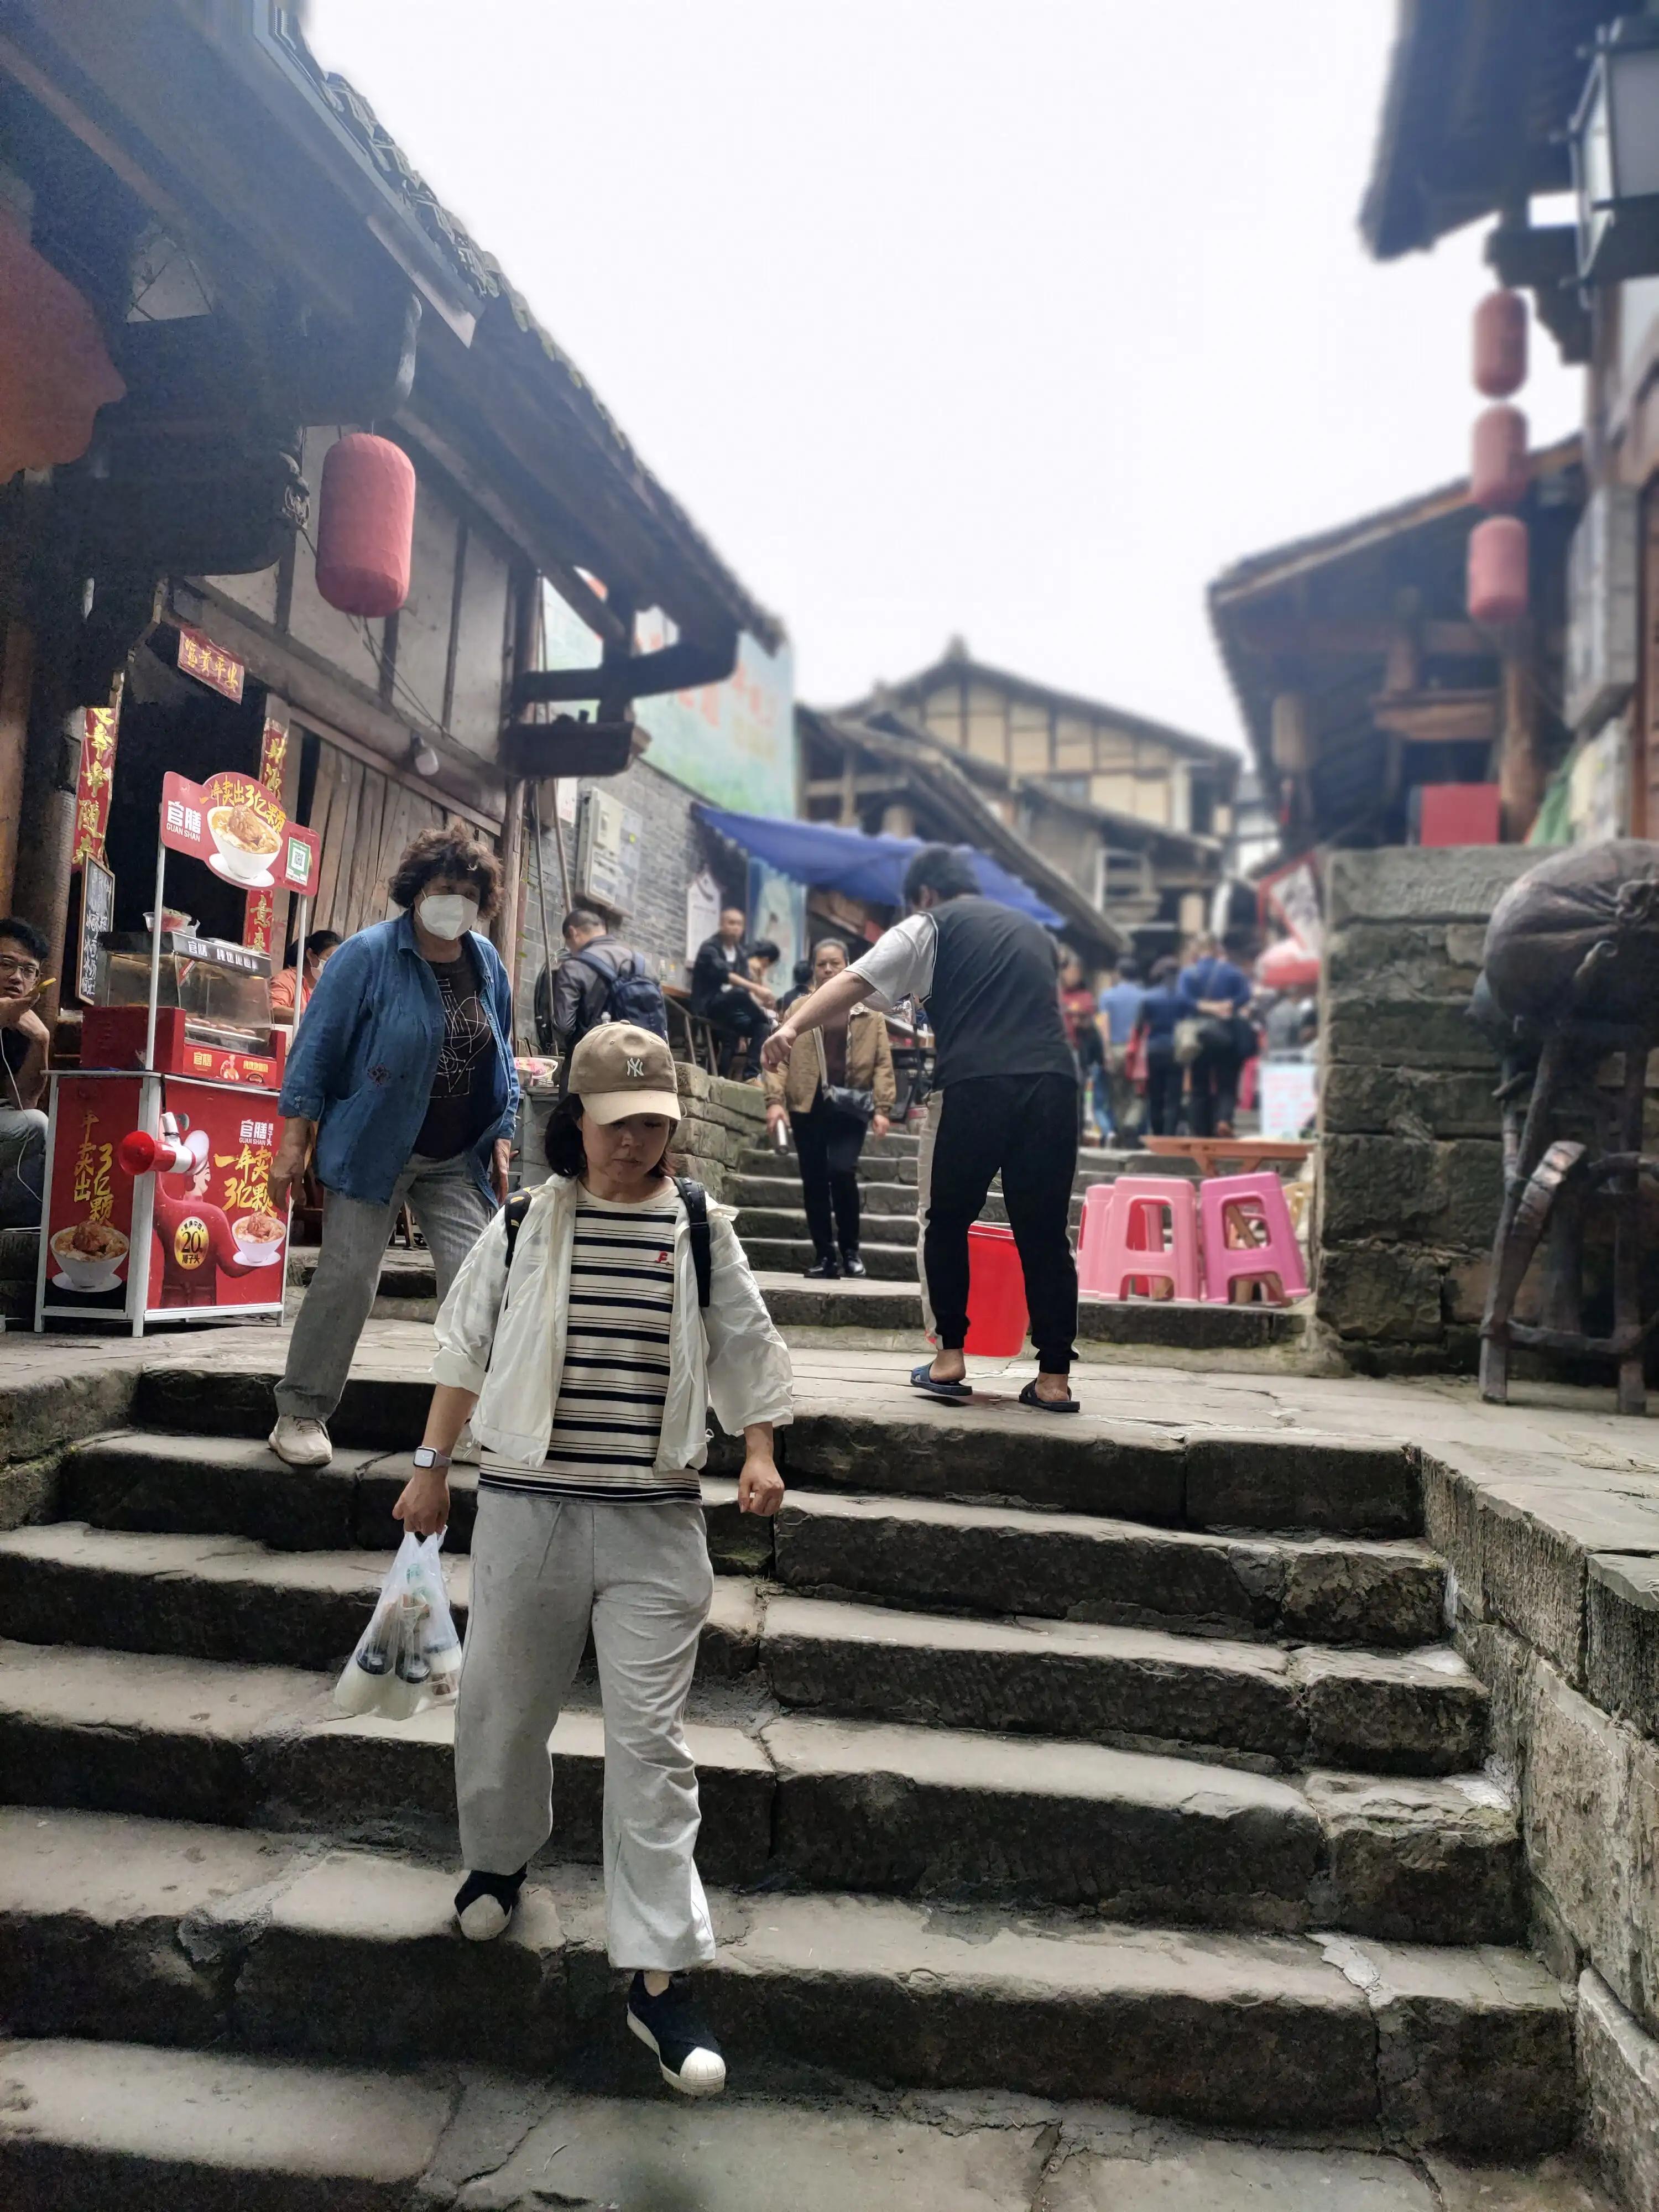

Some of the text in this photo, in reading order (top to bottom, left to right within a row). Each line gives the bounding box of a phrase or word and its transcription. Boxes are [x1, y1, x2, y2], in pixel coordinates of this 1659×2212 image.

[168, 800, 201, 834] 官膳
[166, 823, 200, 842] GUAN SHAN
[627, 1057, 645, 1077] NY
[240, 1119, 268, 1140] 官膳
